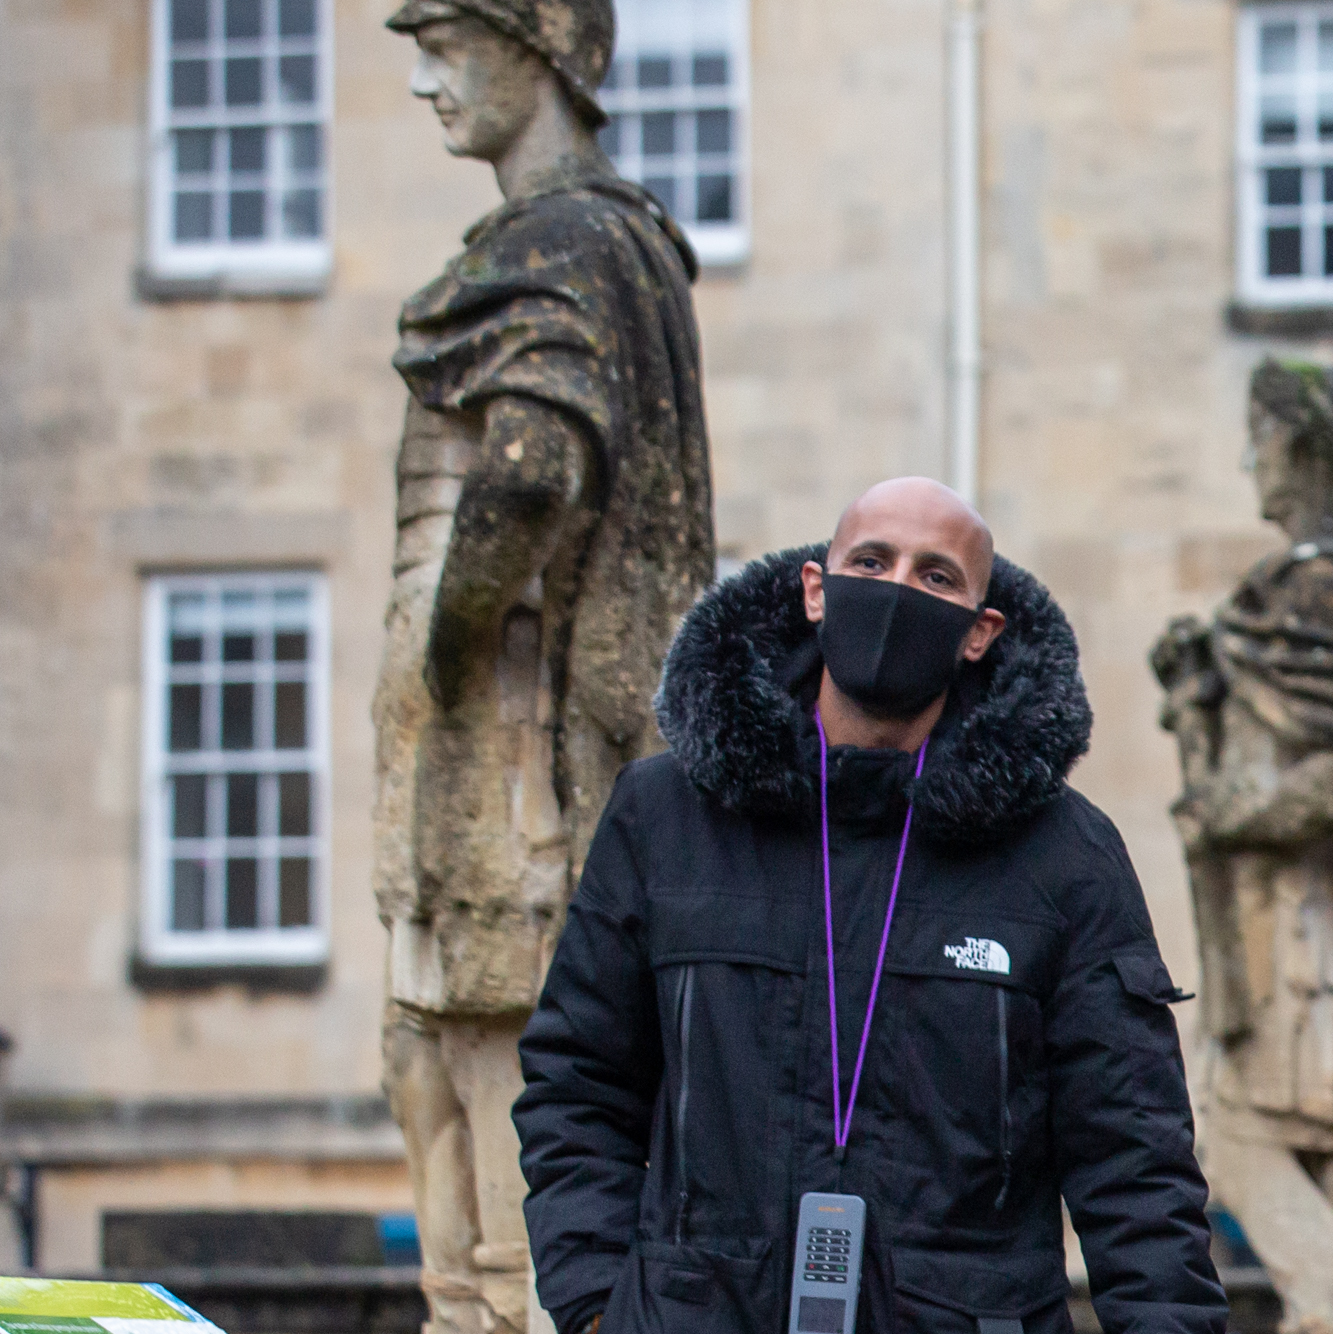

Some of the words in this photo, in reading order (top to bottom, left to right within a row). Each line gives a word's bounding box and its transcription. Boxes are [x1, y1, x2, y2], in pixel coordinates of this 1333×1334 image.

[965, 937, 989, 950] THE
[944, 945, 989, 959] NORTH
[955, 957, 988, 970] FACE
